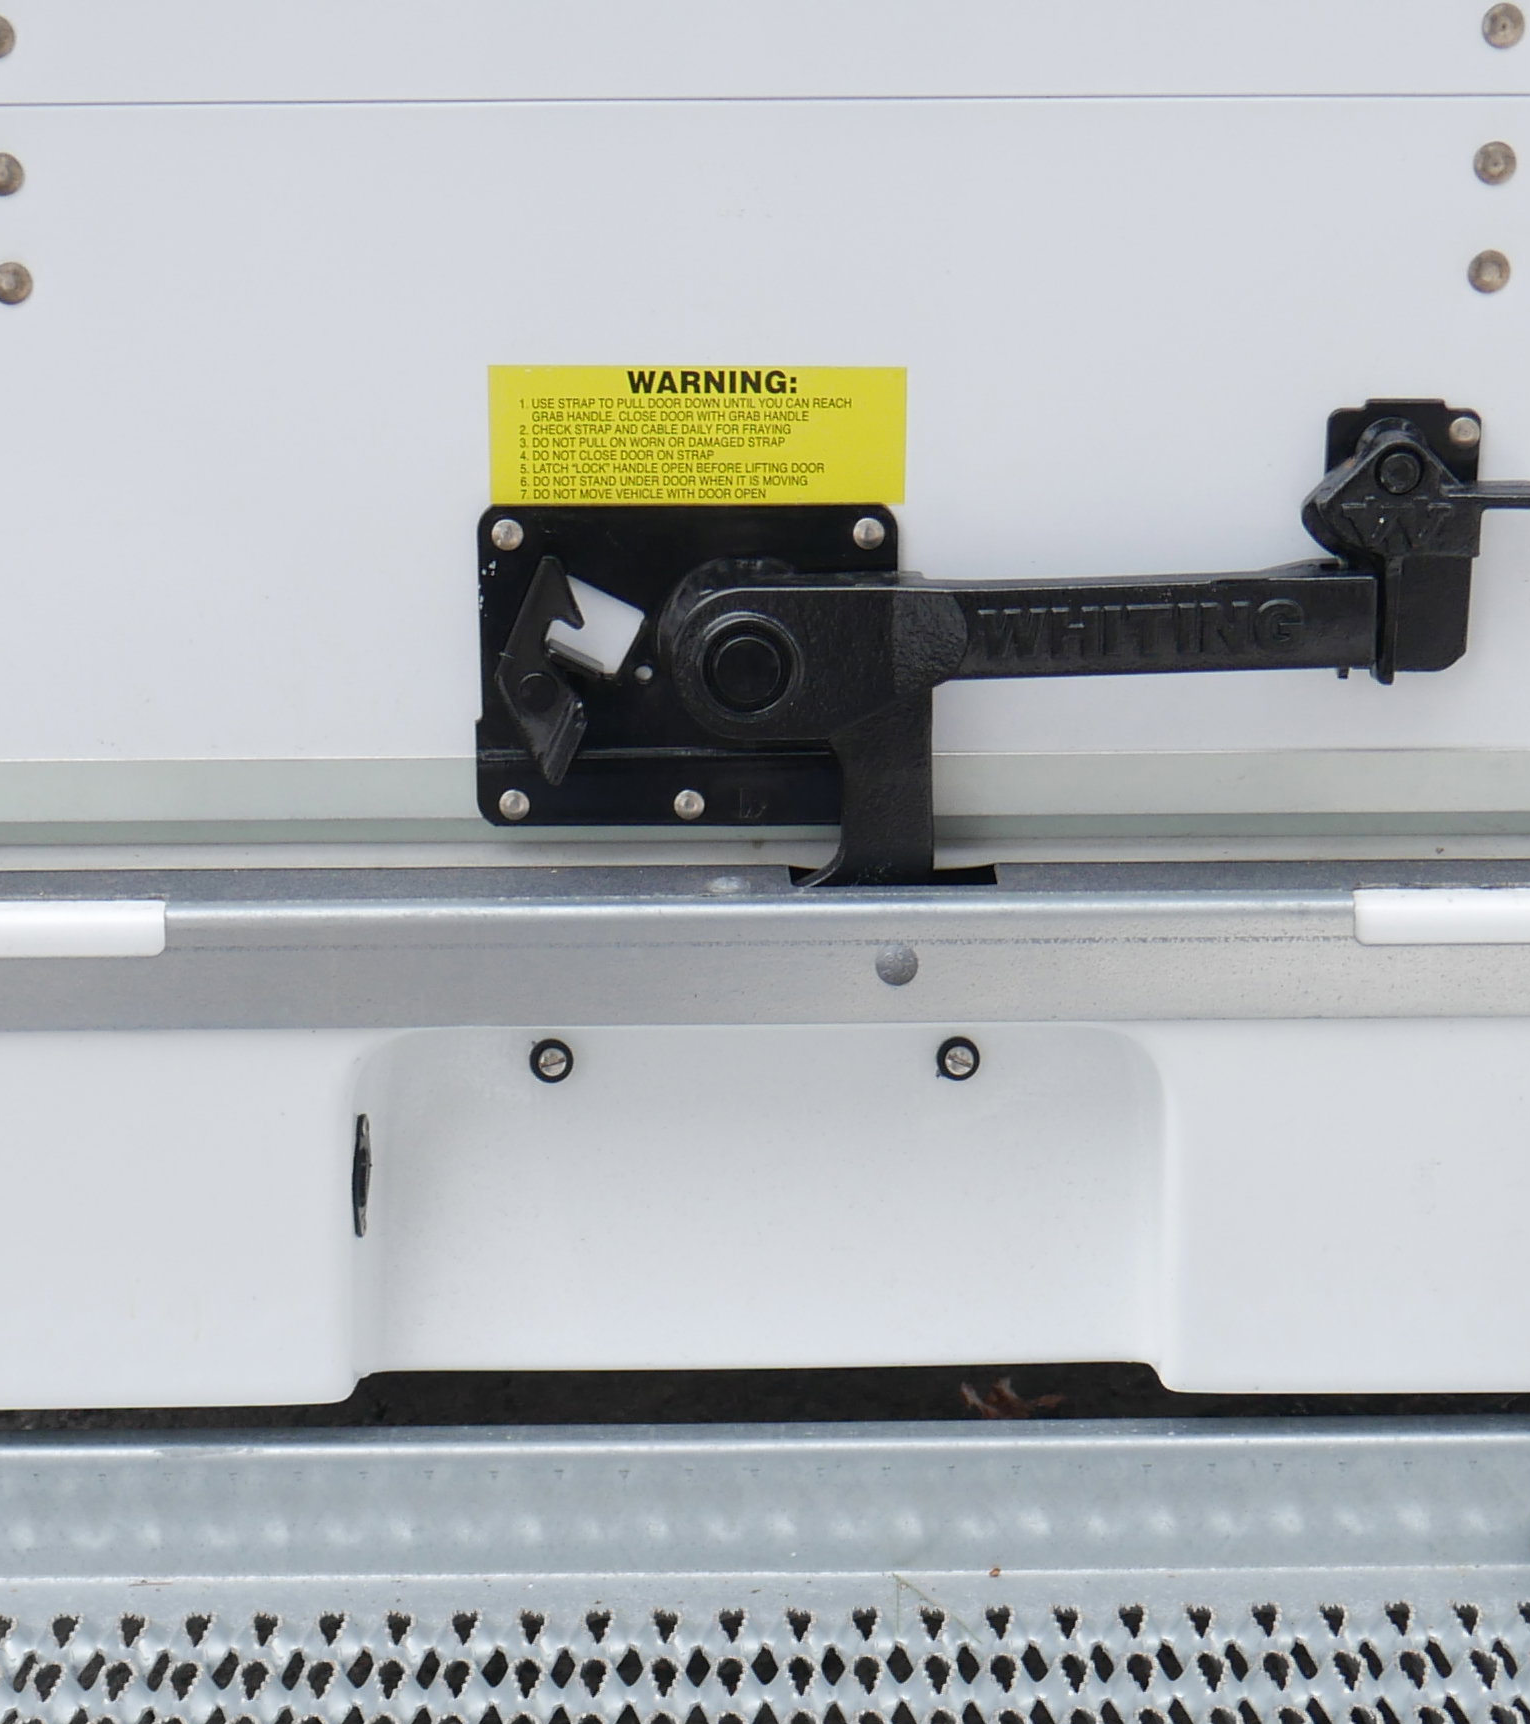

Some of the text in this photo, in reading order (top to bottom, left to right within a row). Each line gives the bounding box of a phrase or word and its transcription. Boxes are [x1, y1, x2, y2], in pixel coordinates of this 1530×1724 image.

[626, 370, 797, 394] WARNING:
[519, 398, 852, 408] 1. USE STRAP TO PULL DOOR DOWN UNTIL YOU CAN REACH
[531, 411, 810, 422] GRAB HANDLE. CLOSE DOOR WITH GRAB HANDLE
[518, 424, 792, 435] 2. CHECK STRAP AND CABLE DAILY FOR FRAYING
[518, 437, 786, 448] 3. DO NOT PULL ON WORN OR DAMAGED STRAP
[519, 450, 715, 461] 4. DO NOT CLOSE DOOR ON STRAP
[519, 463, 825, 473] 5. LATCH "LOCK" HANDLE OPEN BEFORE LIFTING DOOR
[519, 476, 809, 487] 6. DO NOT STAND UNDER DOOR WHEN IT IS MOVING
[520, 488, 767, 499] 7. DO NOT MOVE VEHICLE WITH DOOR OPEN
[976, 598, 1305, 659] WHITING
